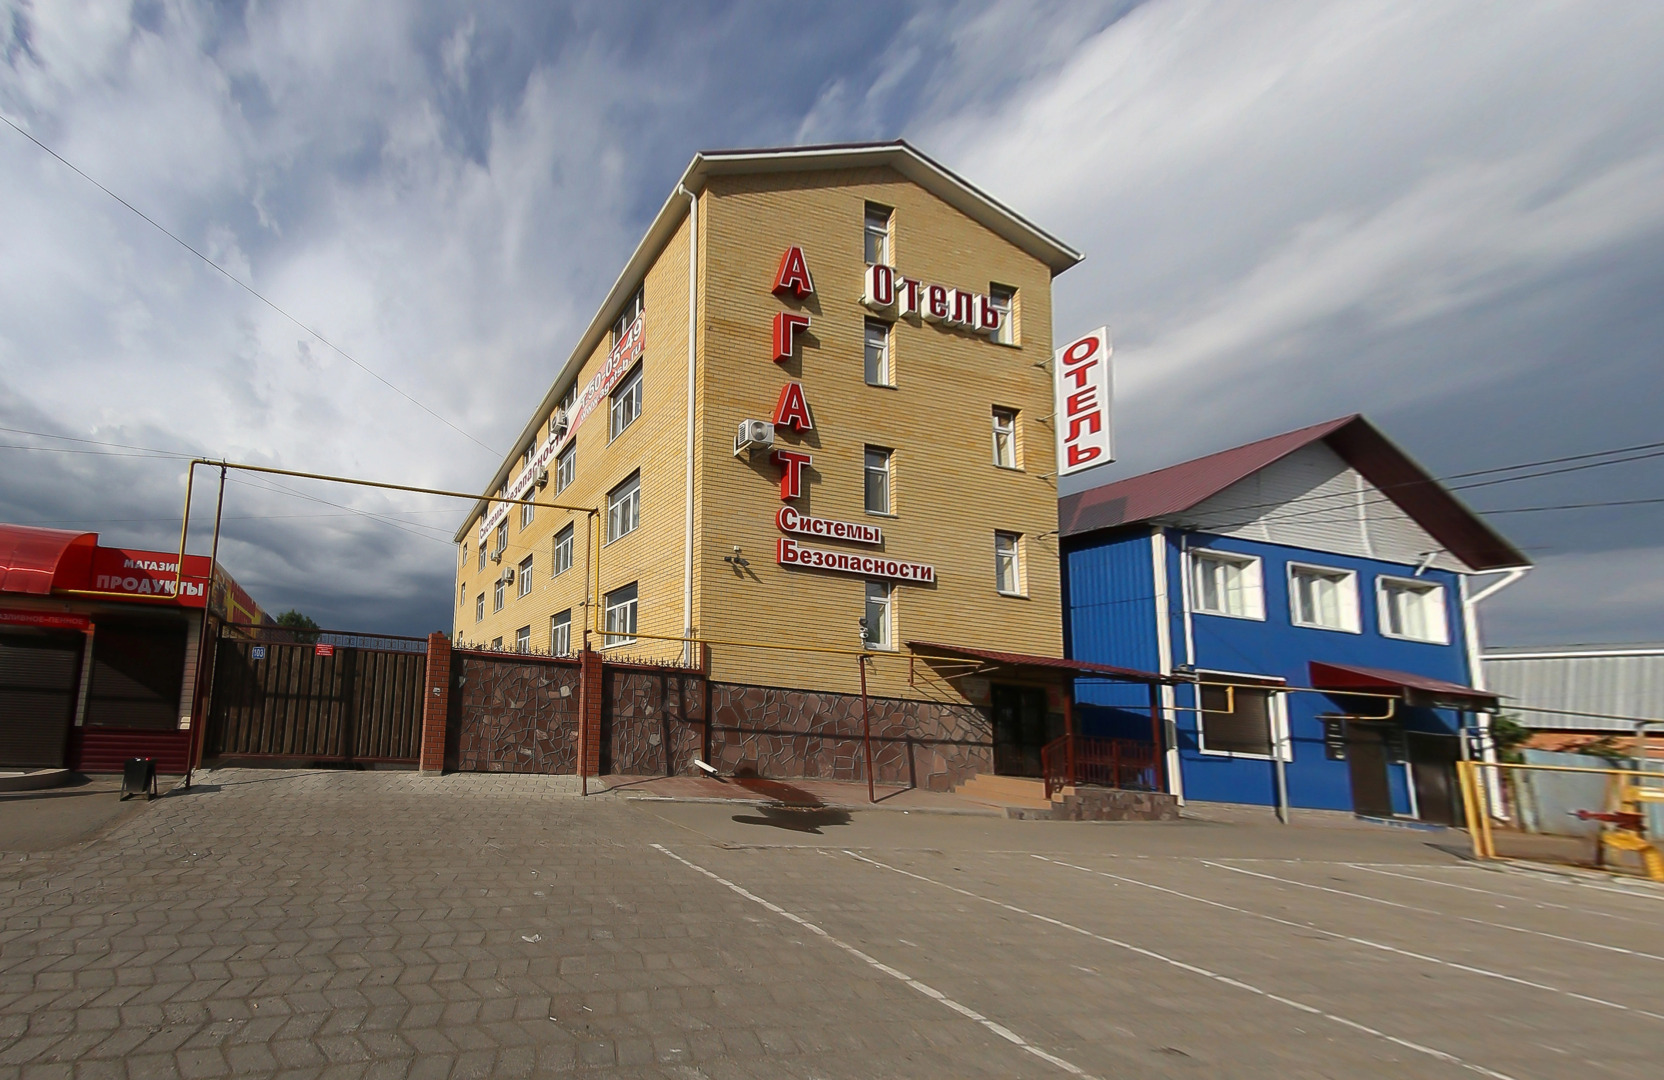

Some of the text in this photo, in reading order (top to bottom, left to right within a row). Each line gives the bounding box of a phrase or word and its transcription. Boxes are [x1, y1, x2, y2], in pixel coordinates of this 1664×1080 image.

[867, 264, 1000, 331] Отель
[773, 245, 813, 500] АГАТ
[1062, 336, 1102, 467] ОТЕЛЬ
[780, 507, 880, 543] Системы
[782, 539, 932, 581] Безопасности
[96, 574, 204, 597] ПРОДУКТЫ
[253, 648, 264, 658] 103
